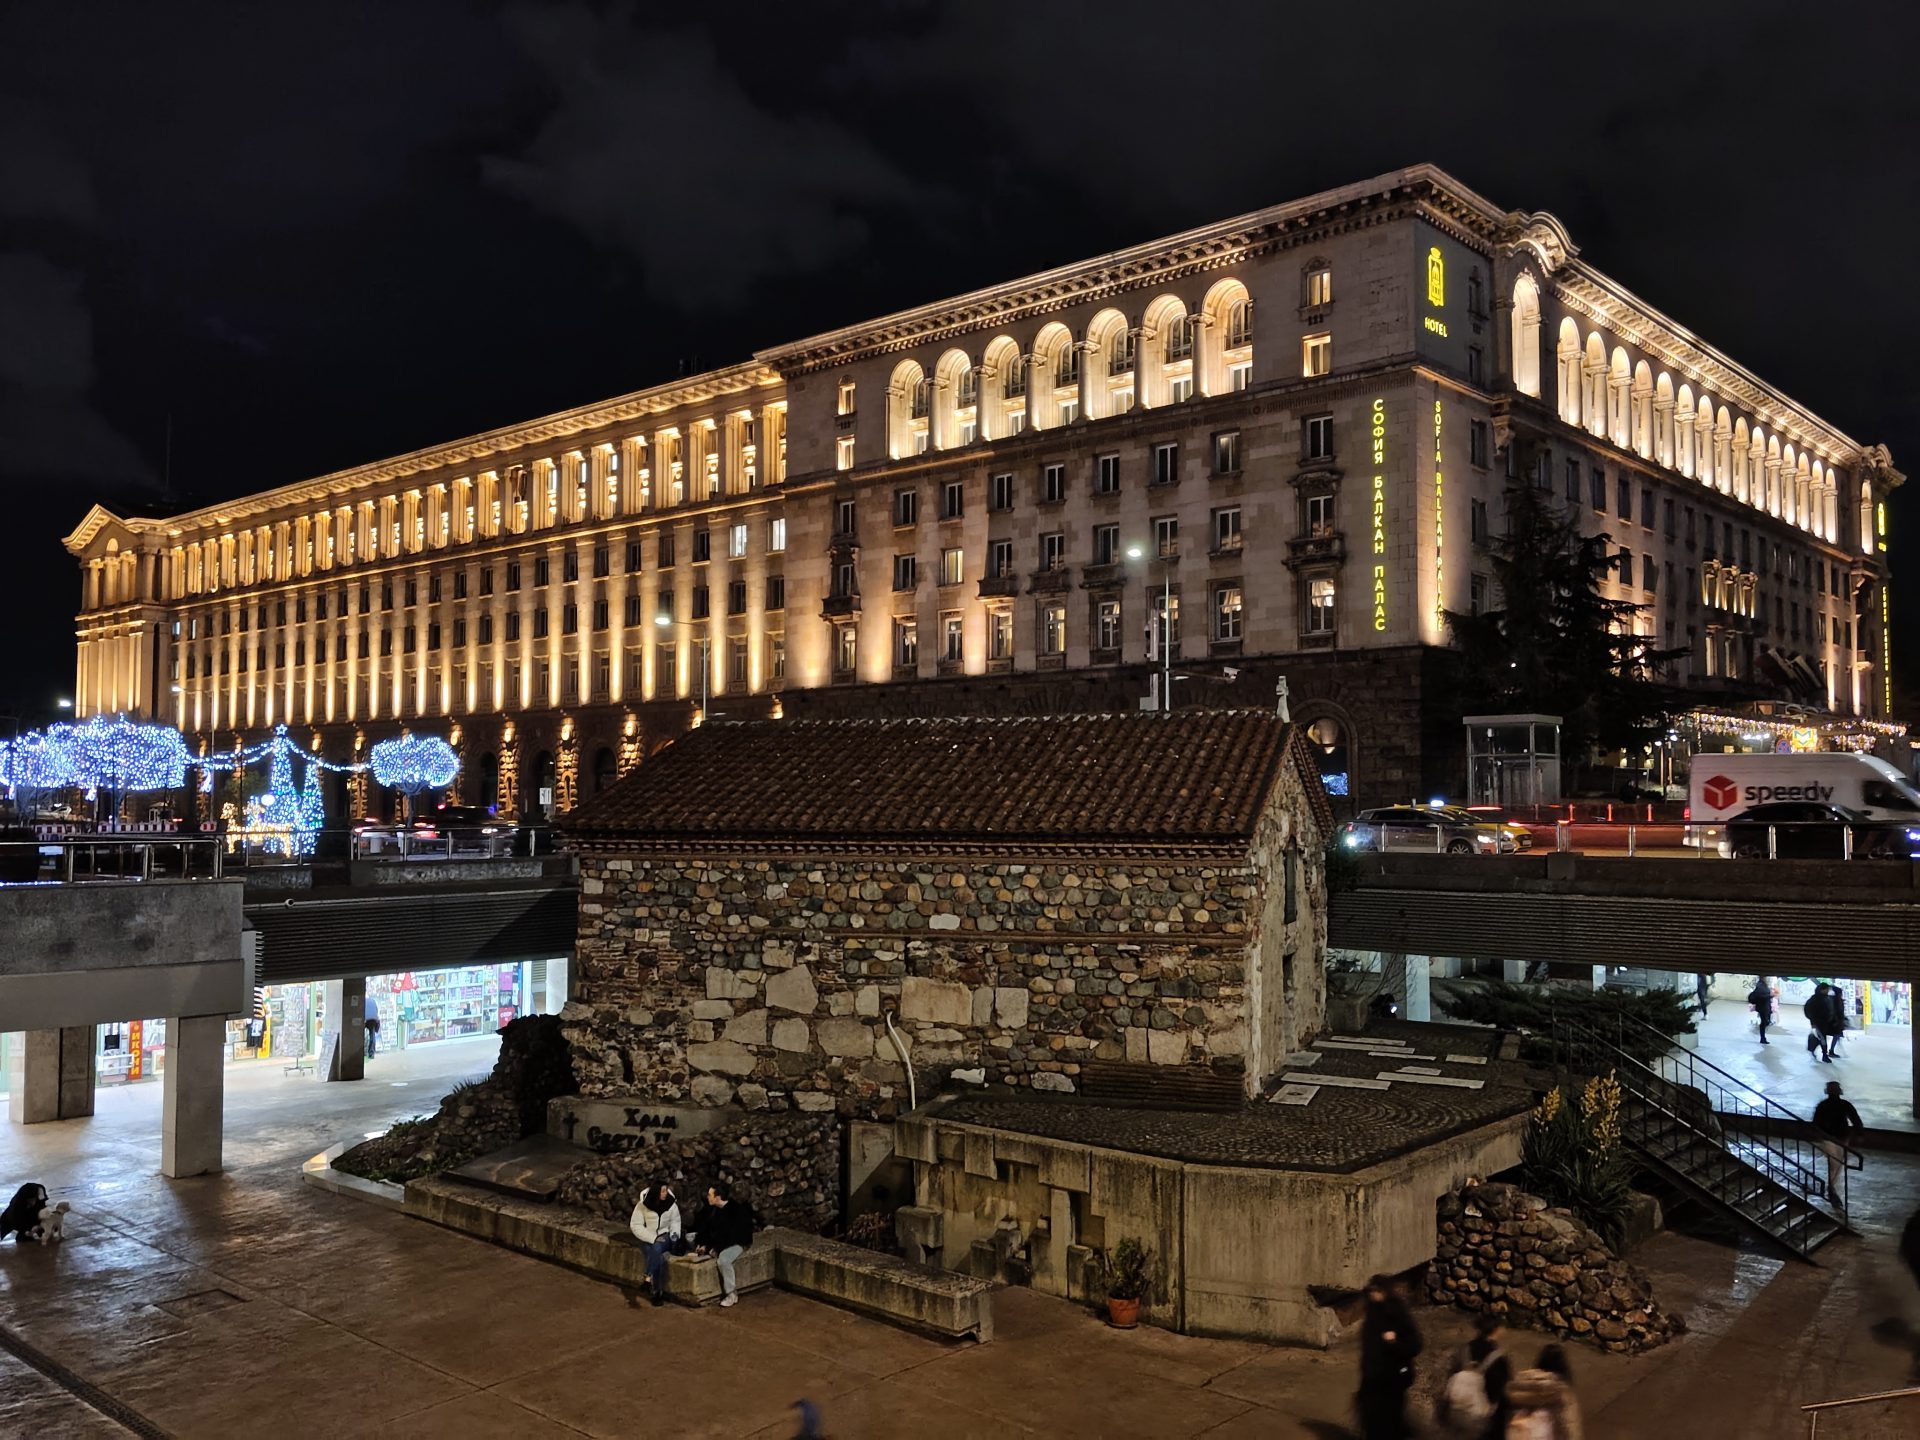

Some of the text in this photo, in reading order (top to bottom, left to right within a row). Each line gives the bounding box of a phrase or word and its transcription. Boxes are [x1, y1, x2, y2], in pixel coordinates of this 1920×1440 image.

[1424, 316, 1448, 338] HOTEL
[1434, 400, 1442, 463] SOFIA
[1373, 398, 1386, 631] СОФИЯ БАЛКАН ПАЛАС
[1744, 780, 1834, 804] speedy
[623, 1107, 678, 1132] Храм
